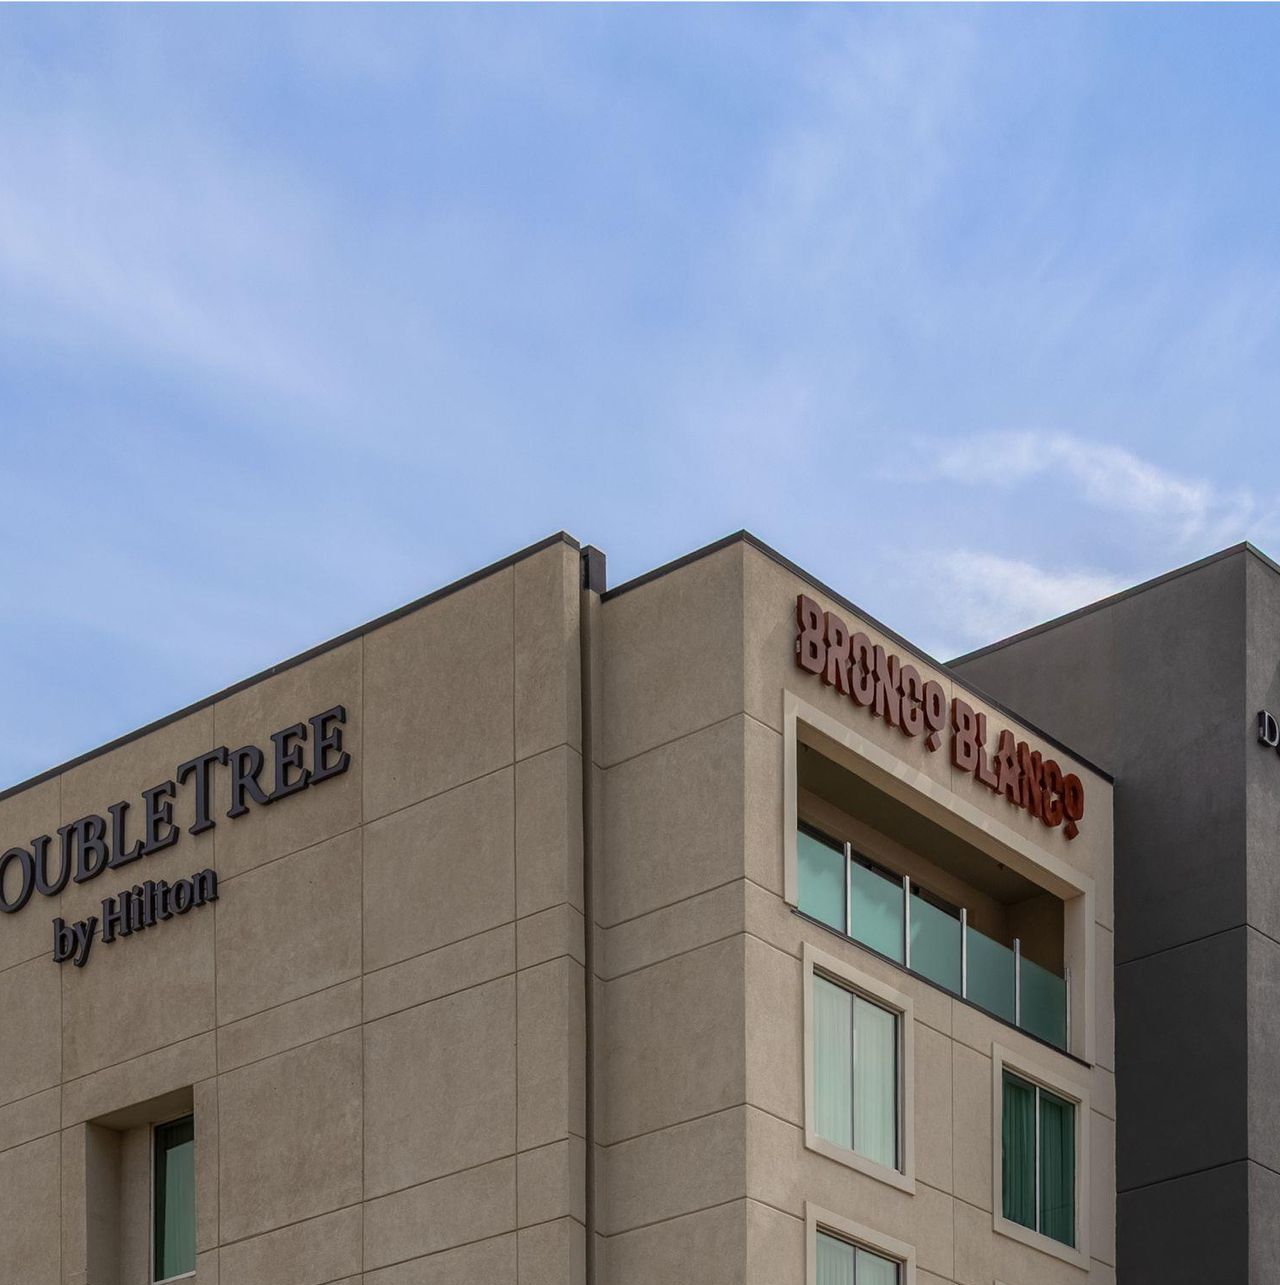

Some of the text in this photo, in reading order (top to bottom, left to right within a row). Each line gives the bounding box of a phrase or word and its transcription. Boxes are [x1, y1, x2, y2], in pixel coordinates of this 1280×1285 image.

[796, 593, 1085, 840] BRONCO BLANCO
[52, 867, 219, 967] by Hilton
